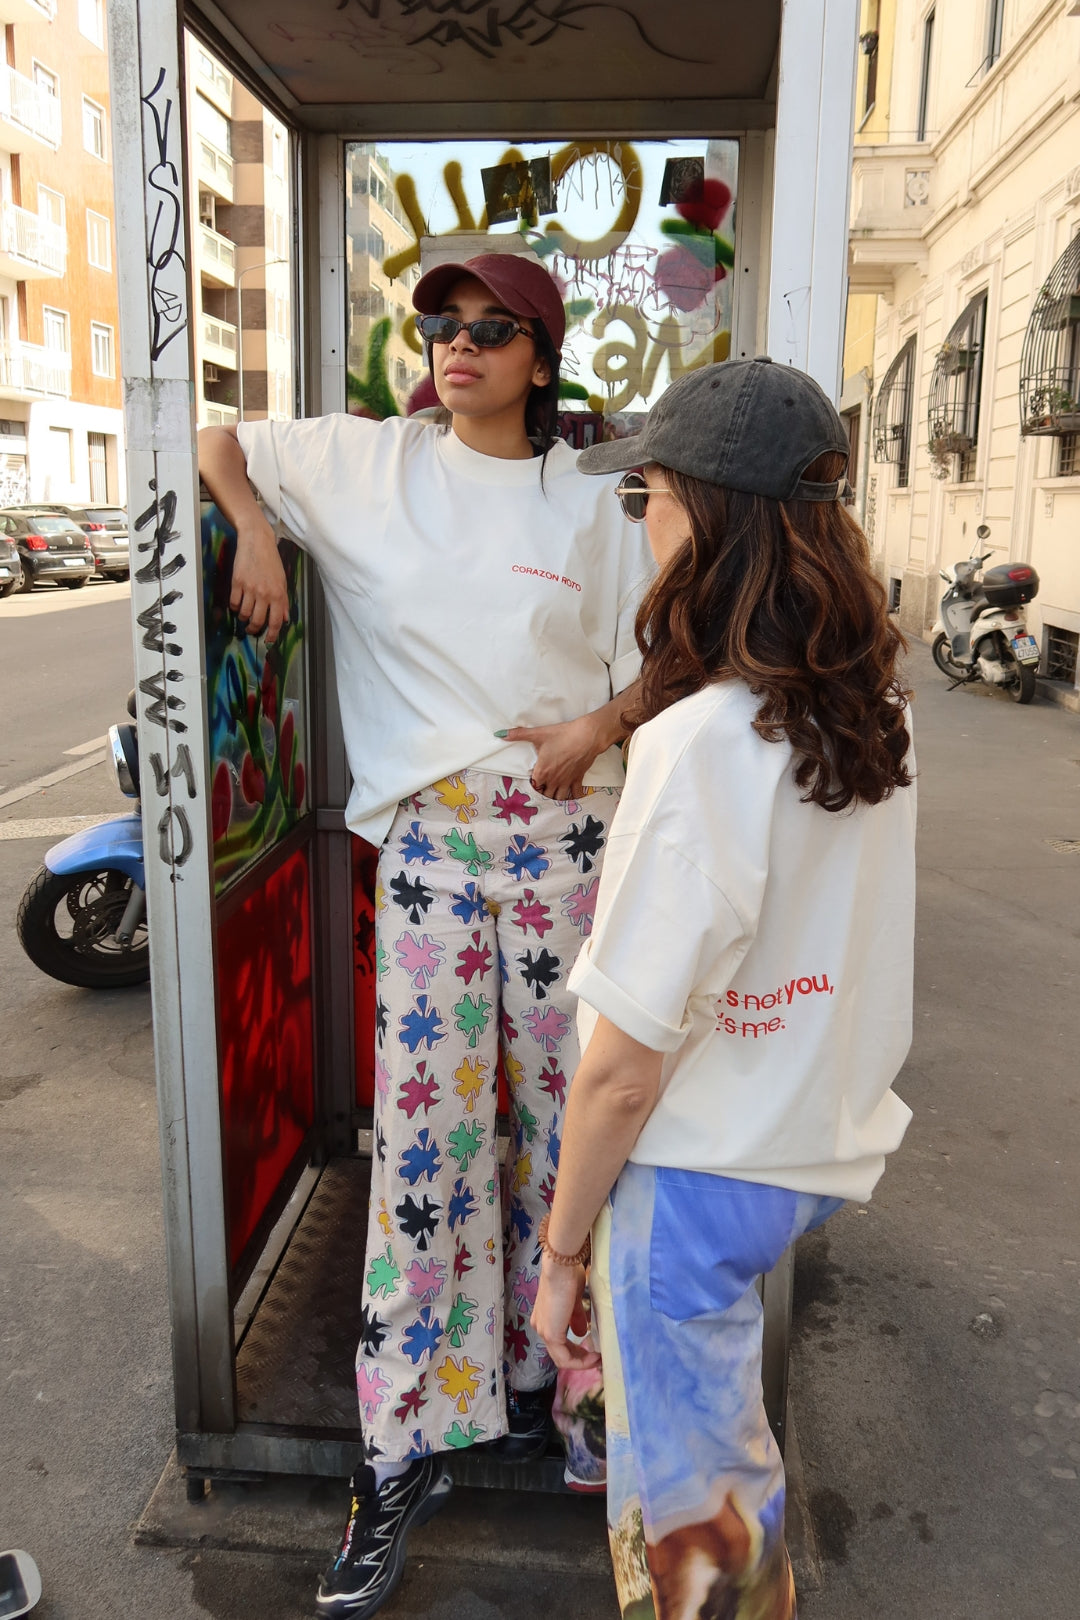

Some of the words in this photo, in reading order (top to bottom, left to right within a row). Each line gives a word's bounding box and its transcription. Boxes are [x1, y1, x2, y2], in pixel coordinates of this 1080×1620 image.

[511, 564, 560, 582] CORAZON
[561, 576, 582, 592] ROTO
[743, 987, 784, 1011] not
[784, 974, 834, 1005] you,
[742, 1017, 786, 1038] me.
